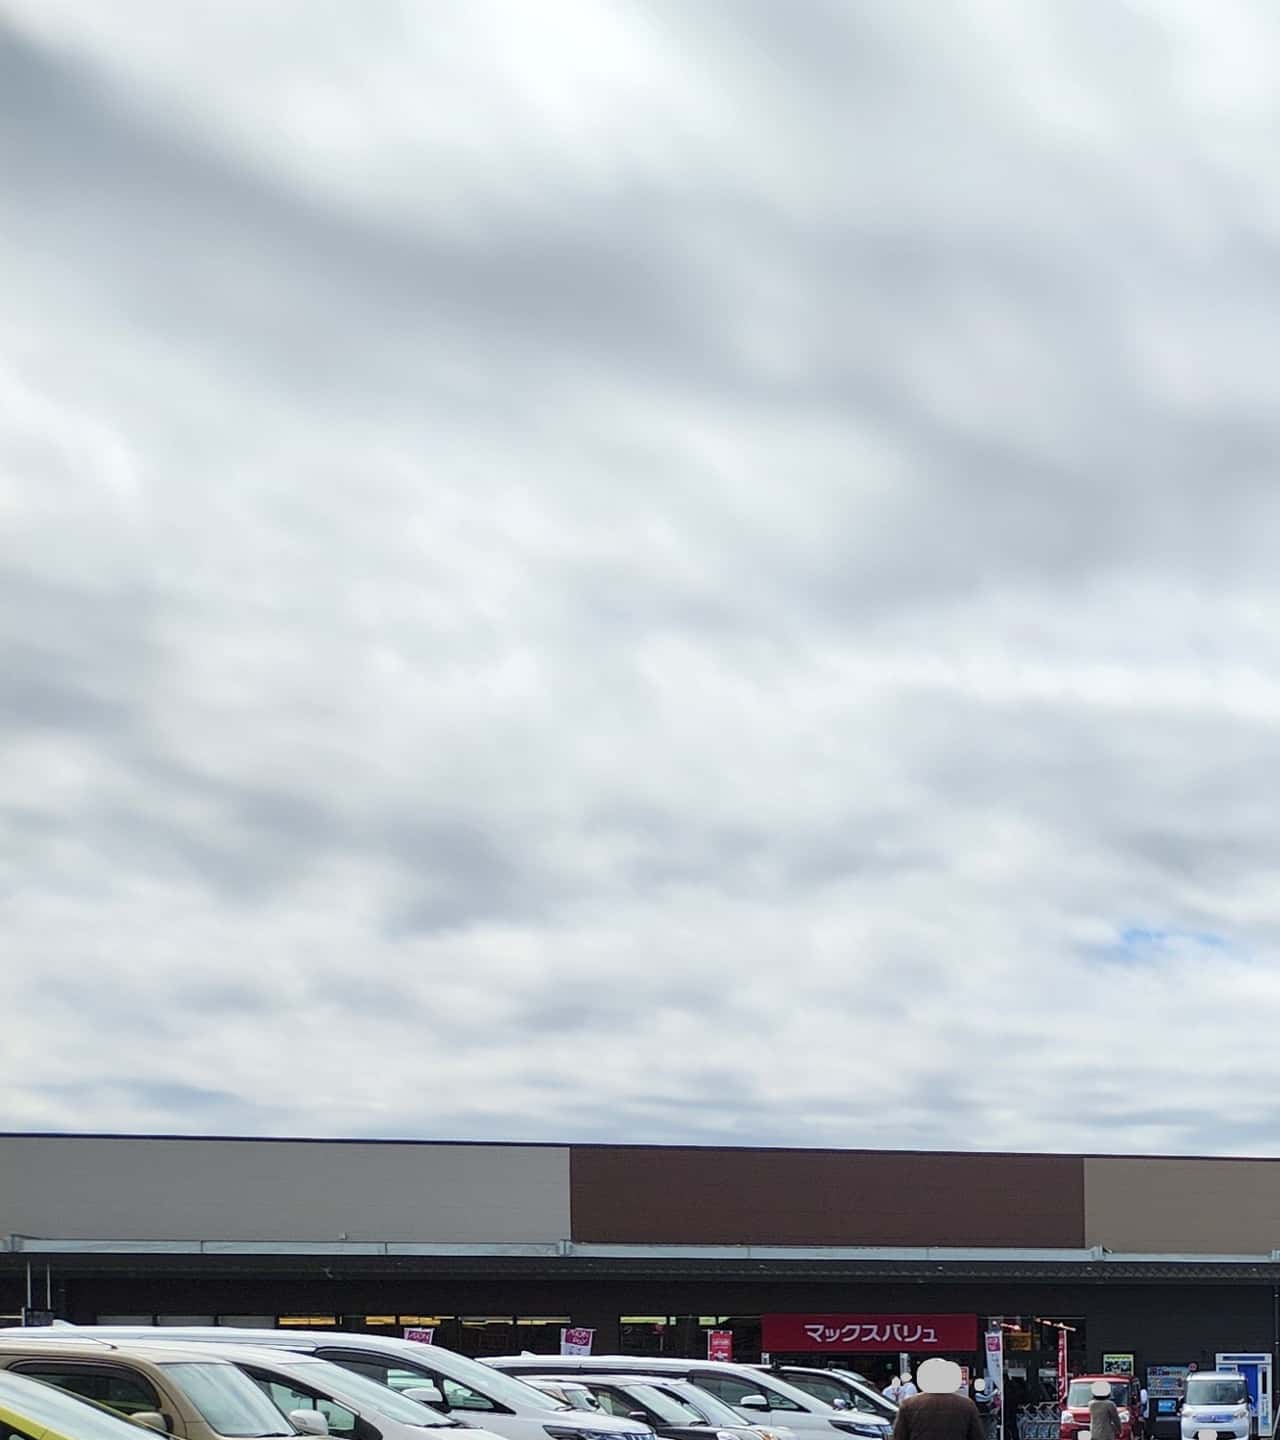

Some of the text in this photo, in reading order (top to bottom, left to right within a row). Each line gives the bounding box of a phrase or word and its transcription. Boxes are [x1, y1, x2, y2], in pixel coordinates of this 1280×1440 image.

[804, 1324, 939, 1344] マックスバリュ
